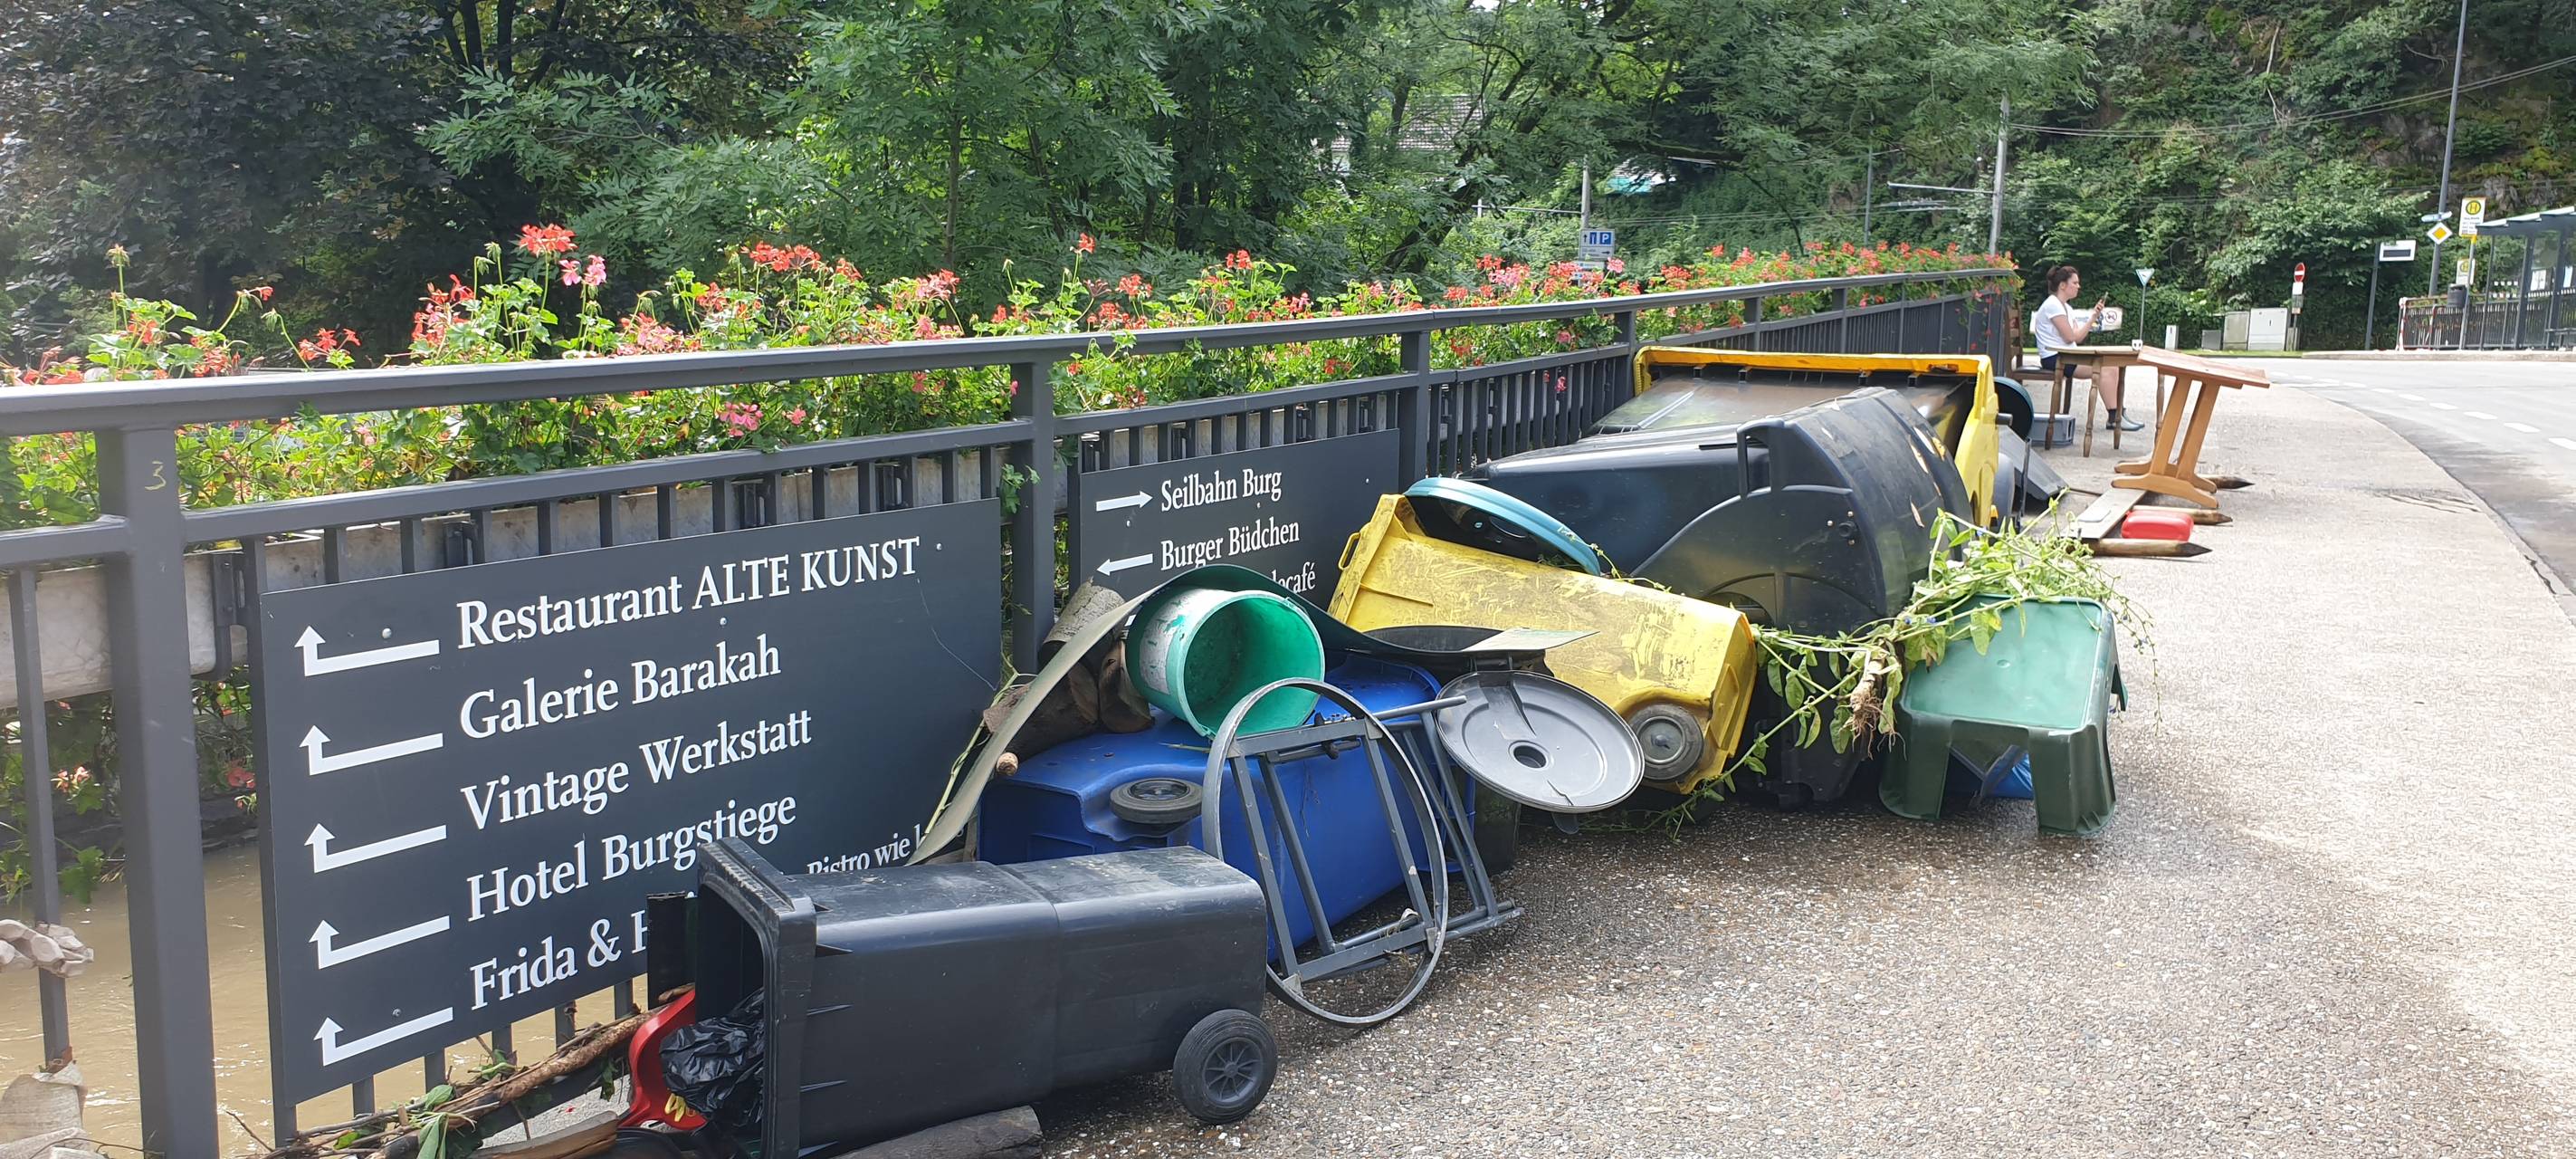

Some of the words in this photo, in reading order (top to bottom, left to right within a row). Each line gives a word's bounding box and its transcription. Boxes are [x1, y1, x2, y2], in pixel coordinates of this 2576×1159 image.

[144, 460, 167, 491] 3
[1161, 470, 1237, 512] Seilbahn
[1243, 468, 1282, 503] Burg
[456, 577, 683, 649] Restaurant
[692, 554, 790, 610] ALTE
[801, 535, 921, 592] KUNST
[1160, 536, 1224, 570] Burger
[1228, 516, 1300, 556] Büdchen
[461, 669, 619, 739] Galerie
[632, 634, 782, 704] Barakah
[460, 762, 629, 830] Vintage
[639, 710, 812, 784] Werkstatt
[467, 840, 589, 922] Hotel
[602, 797, 797, 880] Burgstiege
[470, 936, 578, 1011] Frida
[587, 919, 622, 968] &
[874, 833, 911, 867] wie
